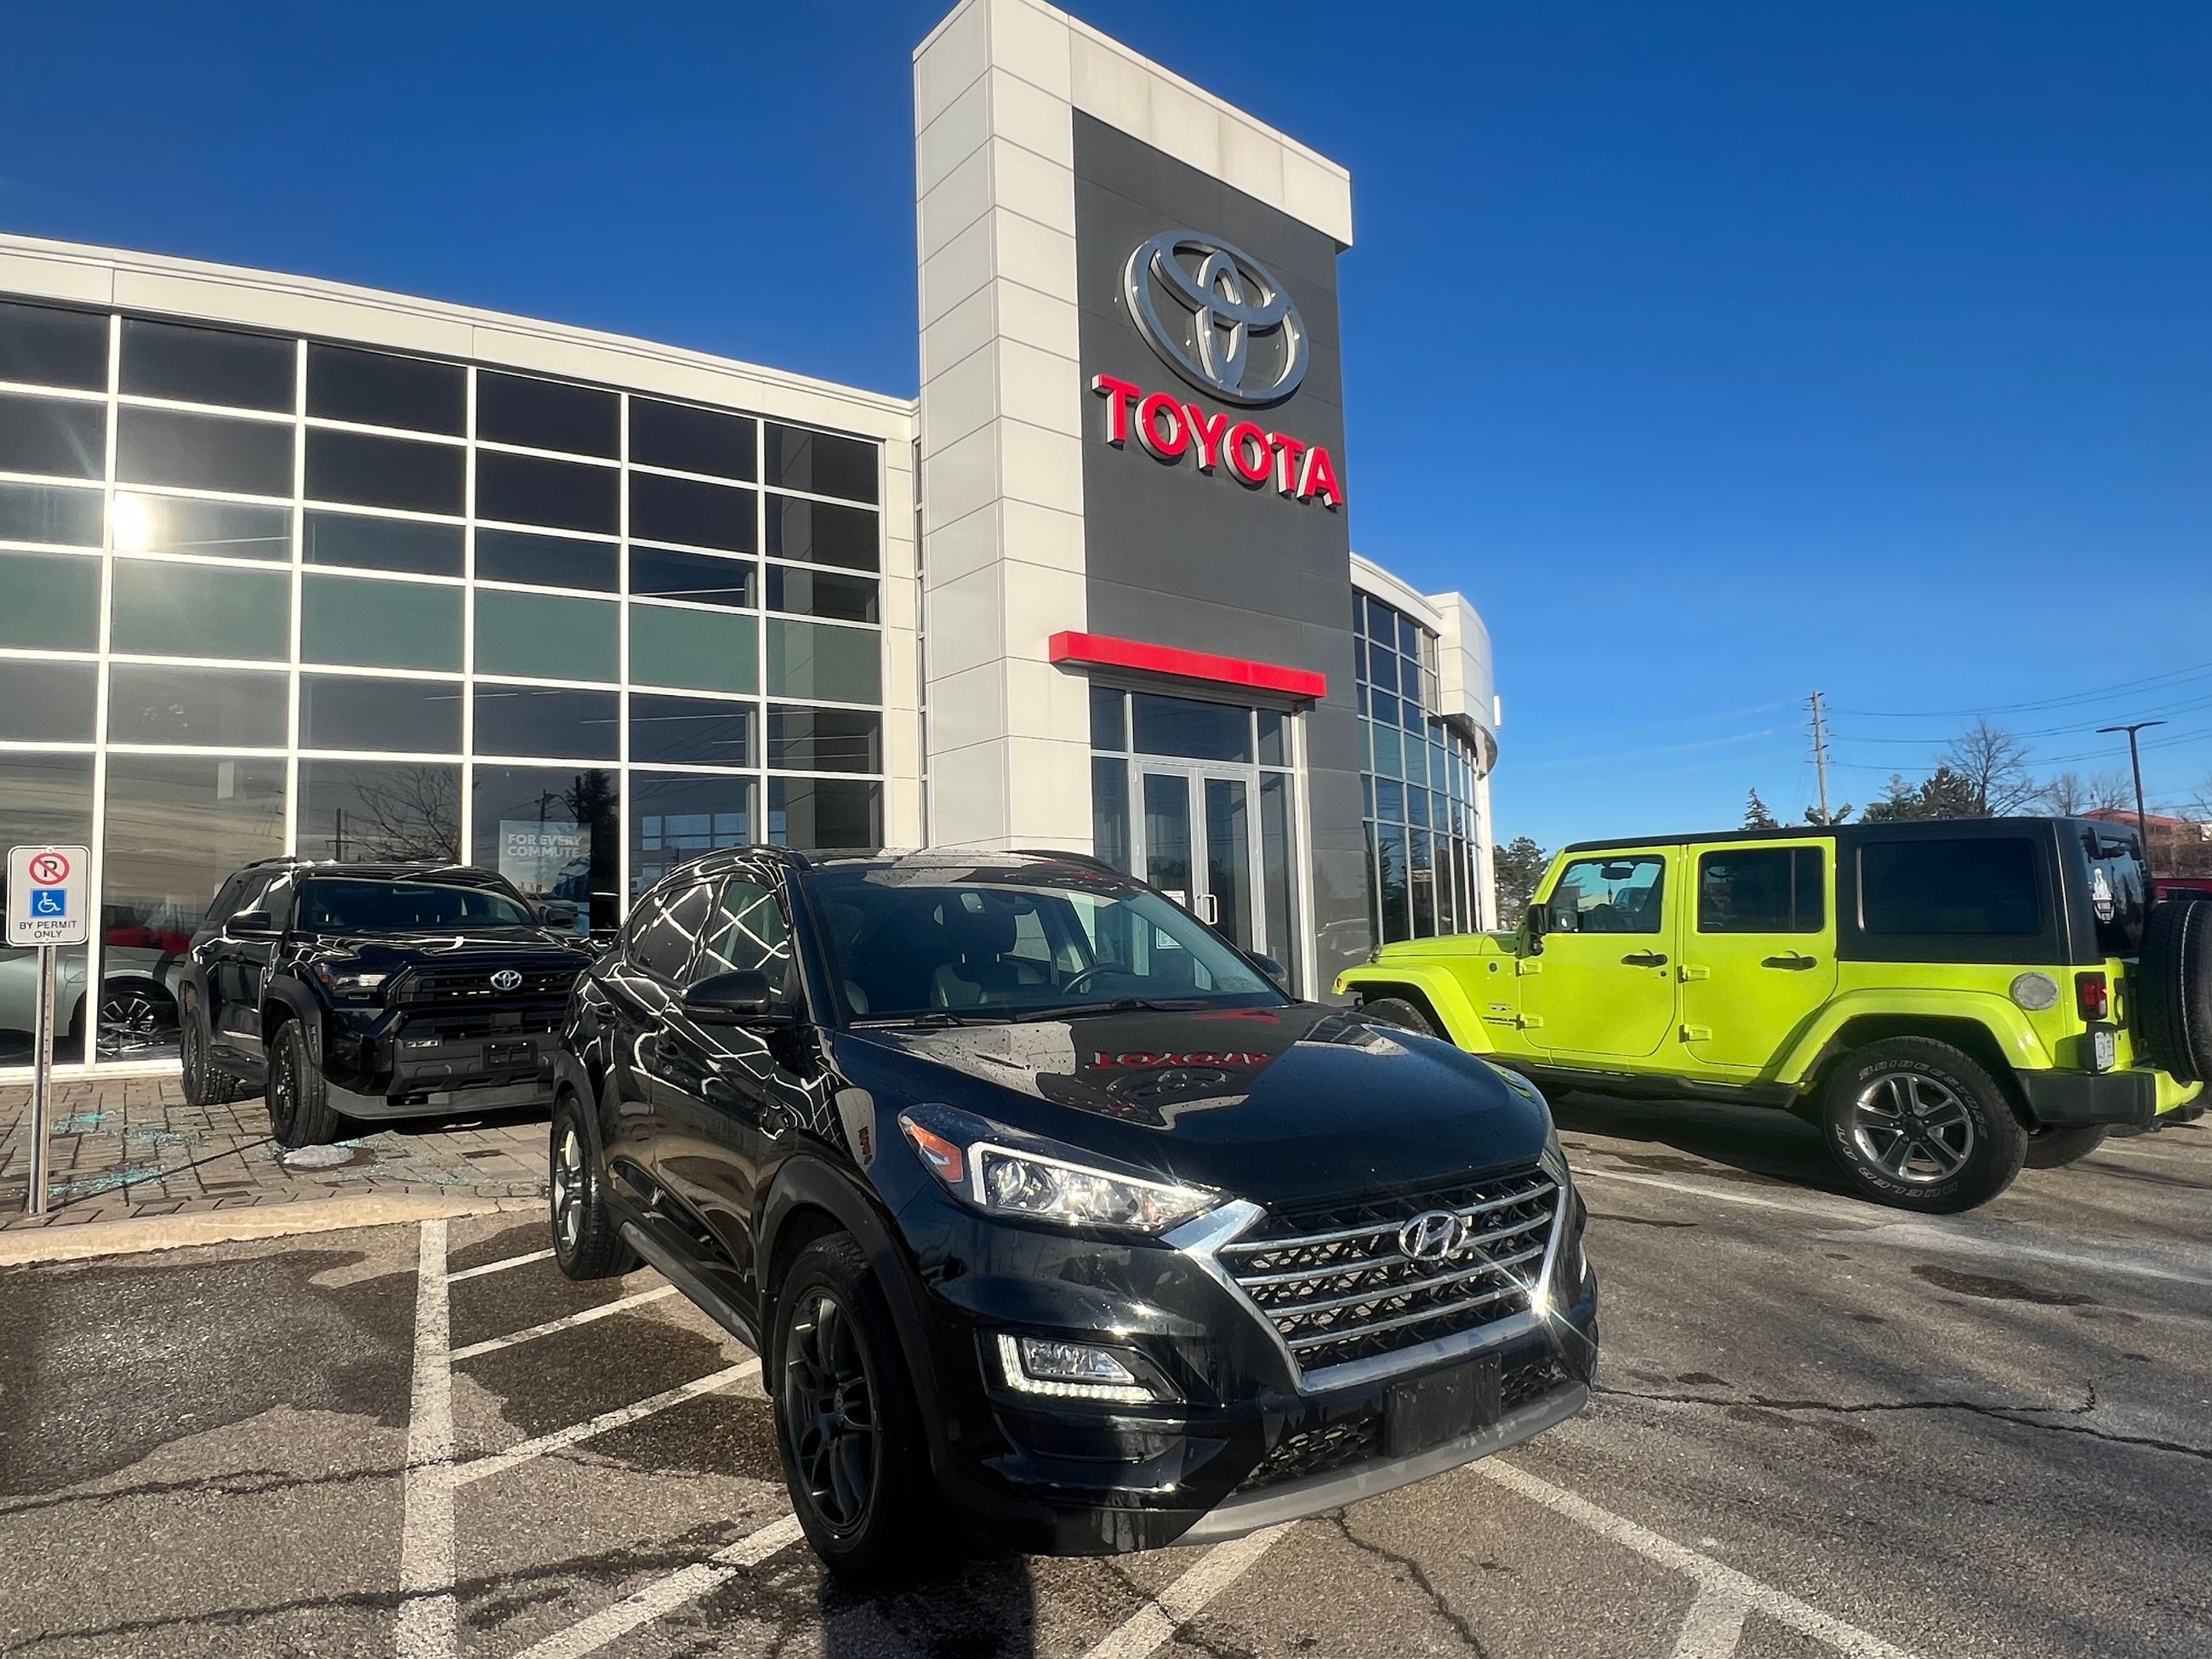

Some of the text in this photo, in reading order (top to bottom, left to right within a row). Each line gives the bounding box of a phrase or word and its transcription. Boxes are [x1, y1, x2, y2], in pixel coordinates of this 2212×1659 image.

[1092, 373, 1344, 507] TOYOTA
[508, 834, 582, 846] FOR EVERY
[509, 846, 579, 858] COMMUTE
[37, 921, 77, 929] PERMIT
[34, 930, 62, 938] ONLY
[1858, 1060, 1988, 1140] BRIDGESTONE
[1858, 1166, 1958, 1198] DUELER
